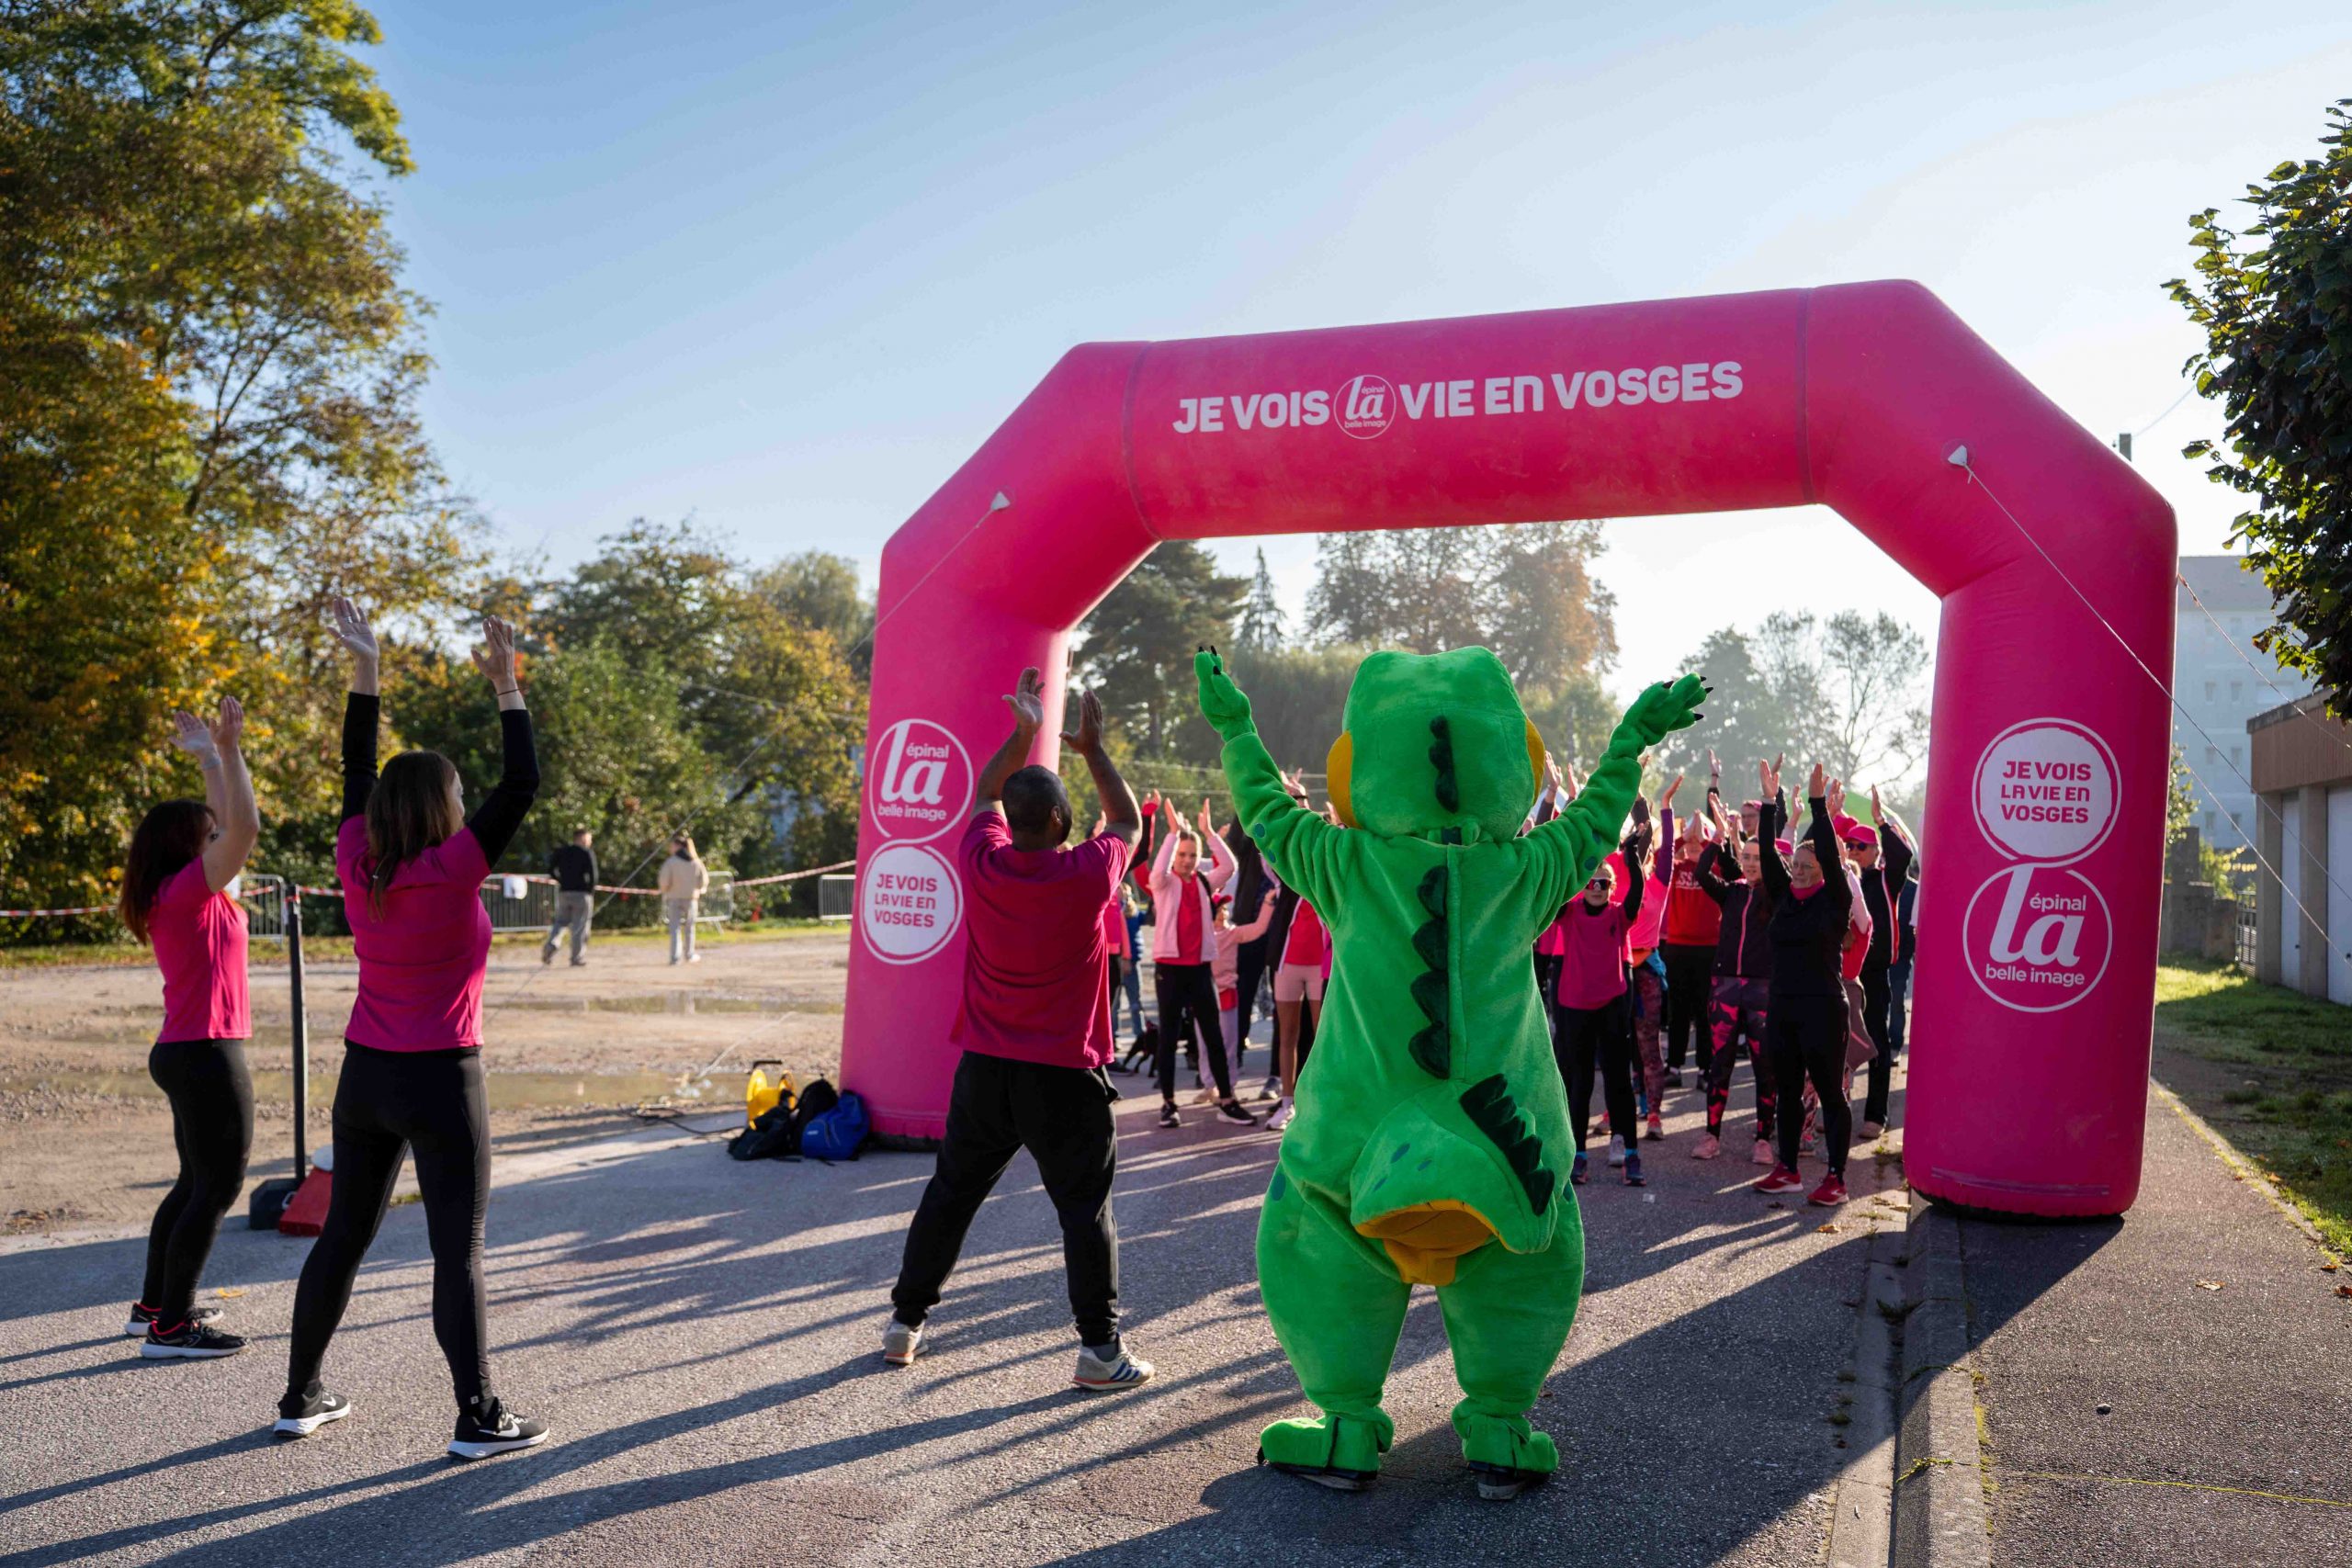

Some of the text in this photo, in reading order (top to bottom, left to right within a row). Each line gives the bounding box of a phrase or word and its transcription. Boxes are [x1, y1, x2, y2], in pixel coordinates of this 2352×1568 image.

[1172, 397, 1224, 434] JE
[1230, 390, 1330, 430] VOIS
[1398, 379, 1475, 420] VIE
[1551, 361, 1744, 410] VOSGES
[905, 743, 950, 760] épinal
[2003, 761, 2091, 781] JE VOIS
[2001, 784, 2025, 799] LA
[2028, 785, 2061, 801] VIE
[877, 804, 947, 821] belle image
[2001, 804, 2088, 824] VOSGES
[876, 874, 937, 892] JE VOIS
[891, 895, 912, 908] VIE
[2029, 893, 2086, 912] épinal
[875, 909, 934, 928] VOSGES
[1985, 964, 2086, 987] belle image
